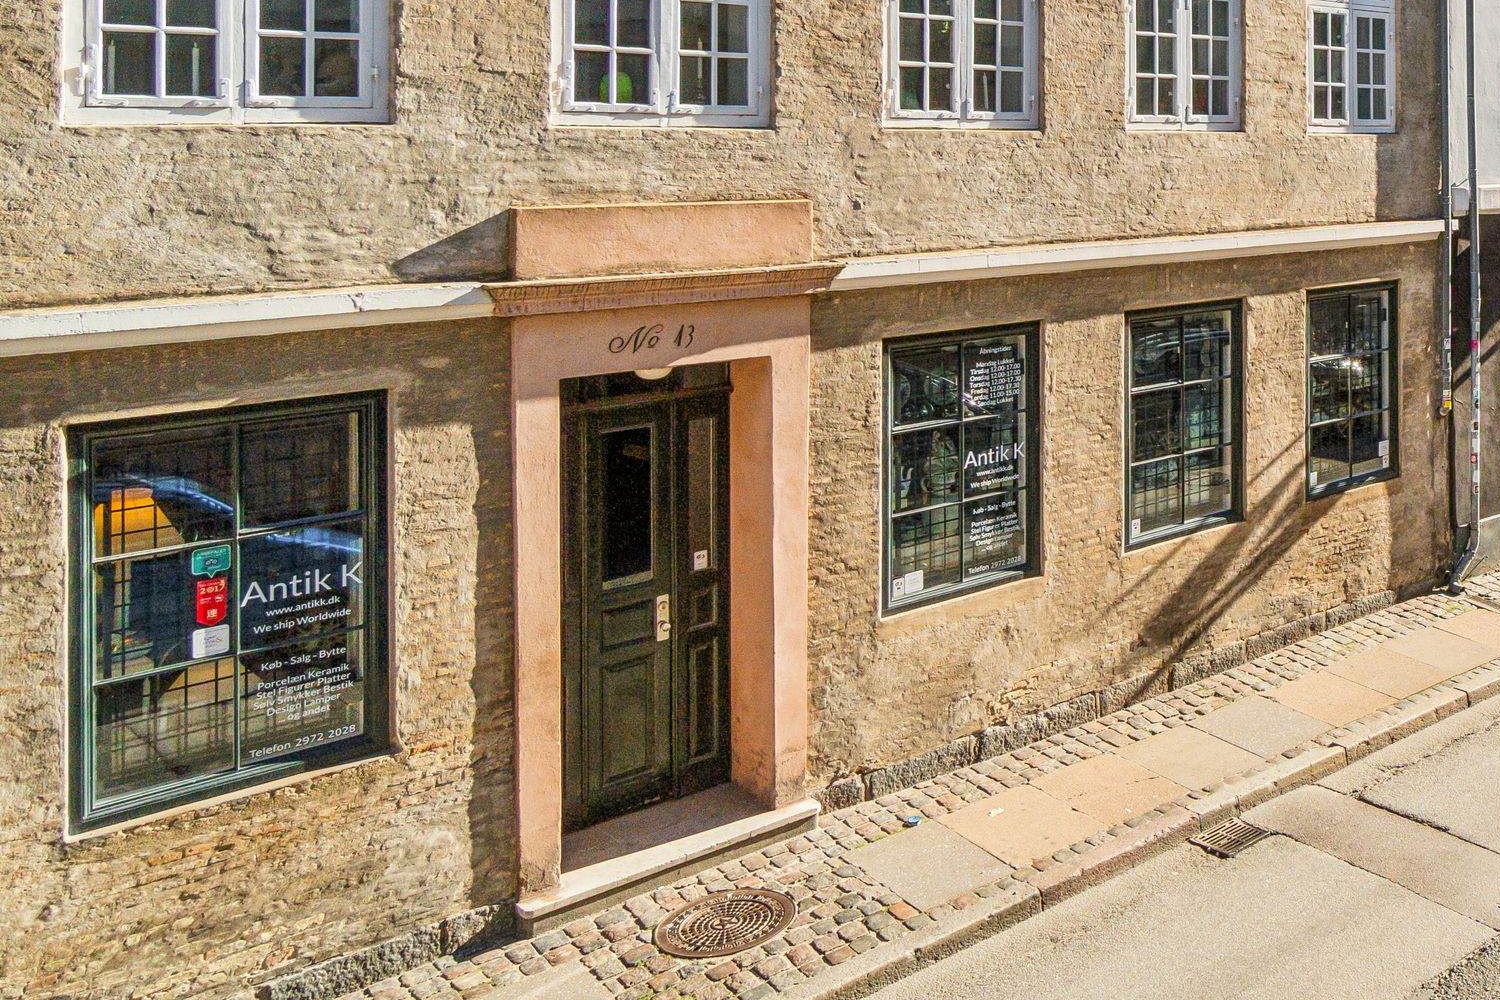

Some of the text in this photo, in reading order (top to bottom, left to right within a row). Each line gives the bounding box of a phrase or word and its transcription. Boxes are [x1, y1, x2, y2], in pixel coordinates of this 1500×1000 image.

[673, 324, 695, 349] 13
[976, 357, 1015, 368] Mandag Lukket
[970, 387, 989, 395] Fredag
[996, 396, 1014, 404] Lukket
[963, 441, 1025, 469] Antik K
[991, 474, 1020, 484] Worldwide
[982, 523, 1000, 532] Figurer
[1001, 519, 1018, 527] Platter
[996, 512, 1017, 521] Keramik
[975, 538, 993, 547] Design
[968, 555, 1022, 574] Telefon 2972 2028
[240, 561, 364, 608] Antik K
[265, 595, 341, 617] www.antikk.dk
[253, 608, 352, 635] We ship Worldwide
[261, 660, 282, 672] Køb
[290, 654, 311, 665] Salg
[319, 647, 347, 660] Bytte
[256, 672, 351, 700] Stel Figurer Platter
[257, 663, 350, 690] Porcelæn Keramik
[253, 680, 354, 711] Sølv Smykker Bestik
[266, 693, 341, 717] Design Lamper
[287, 712, 300, 722] og
[302, 704, 331, 717] andet
[249, 724, 356, 758] Telefon 2972 2028
